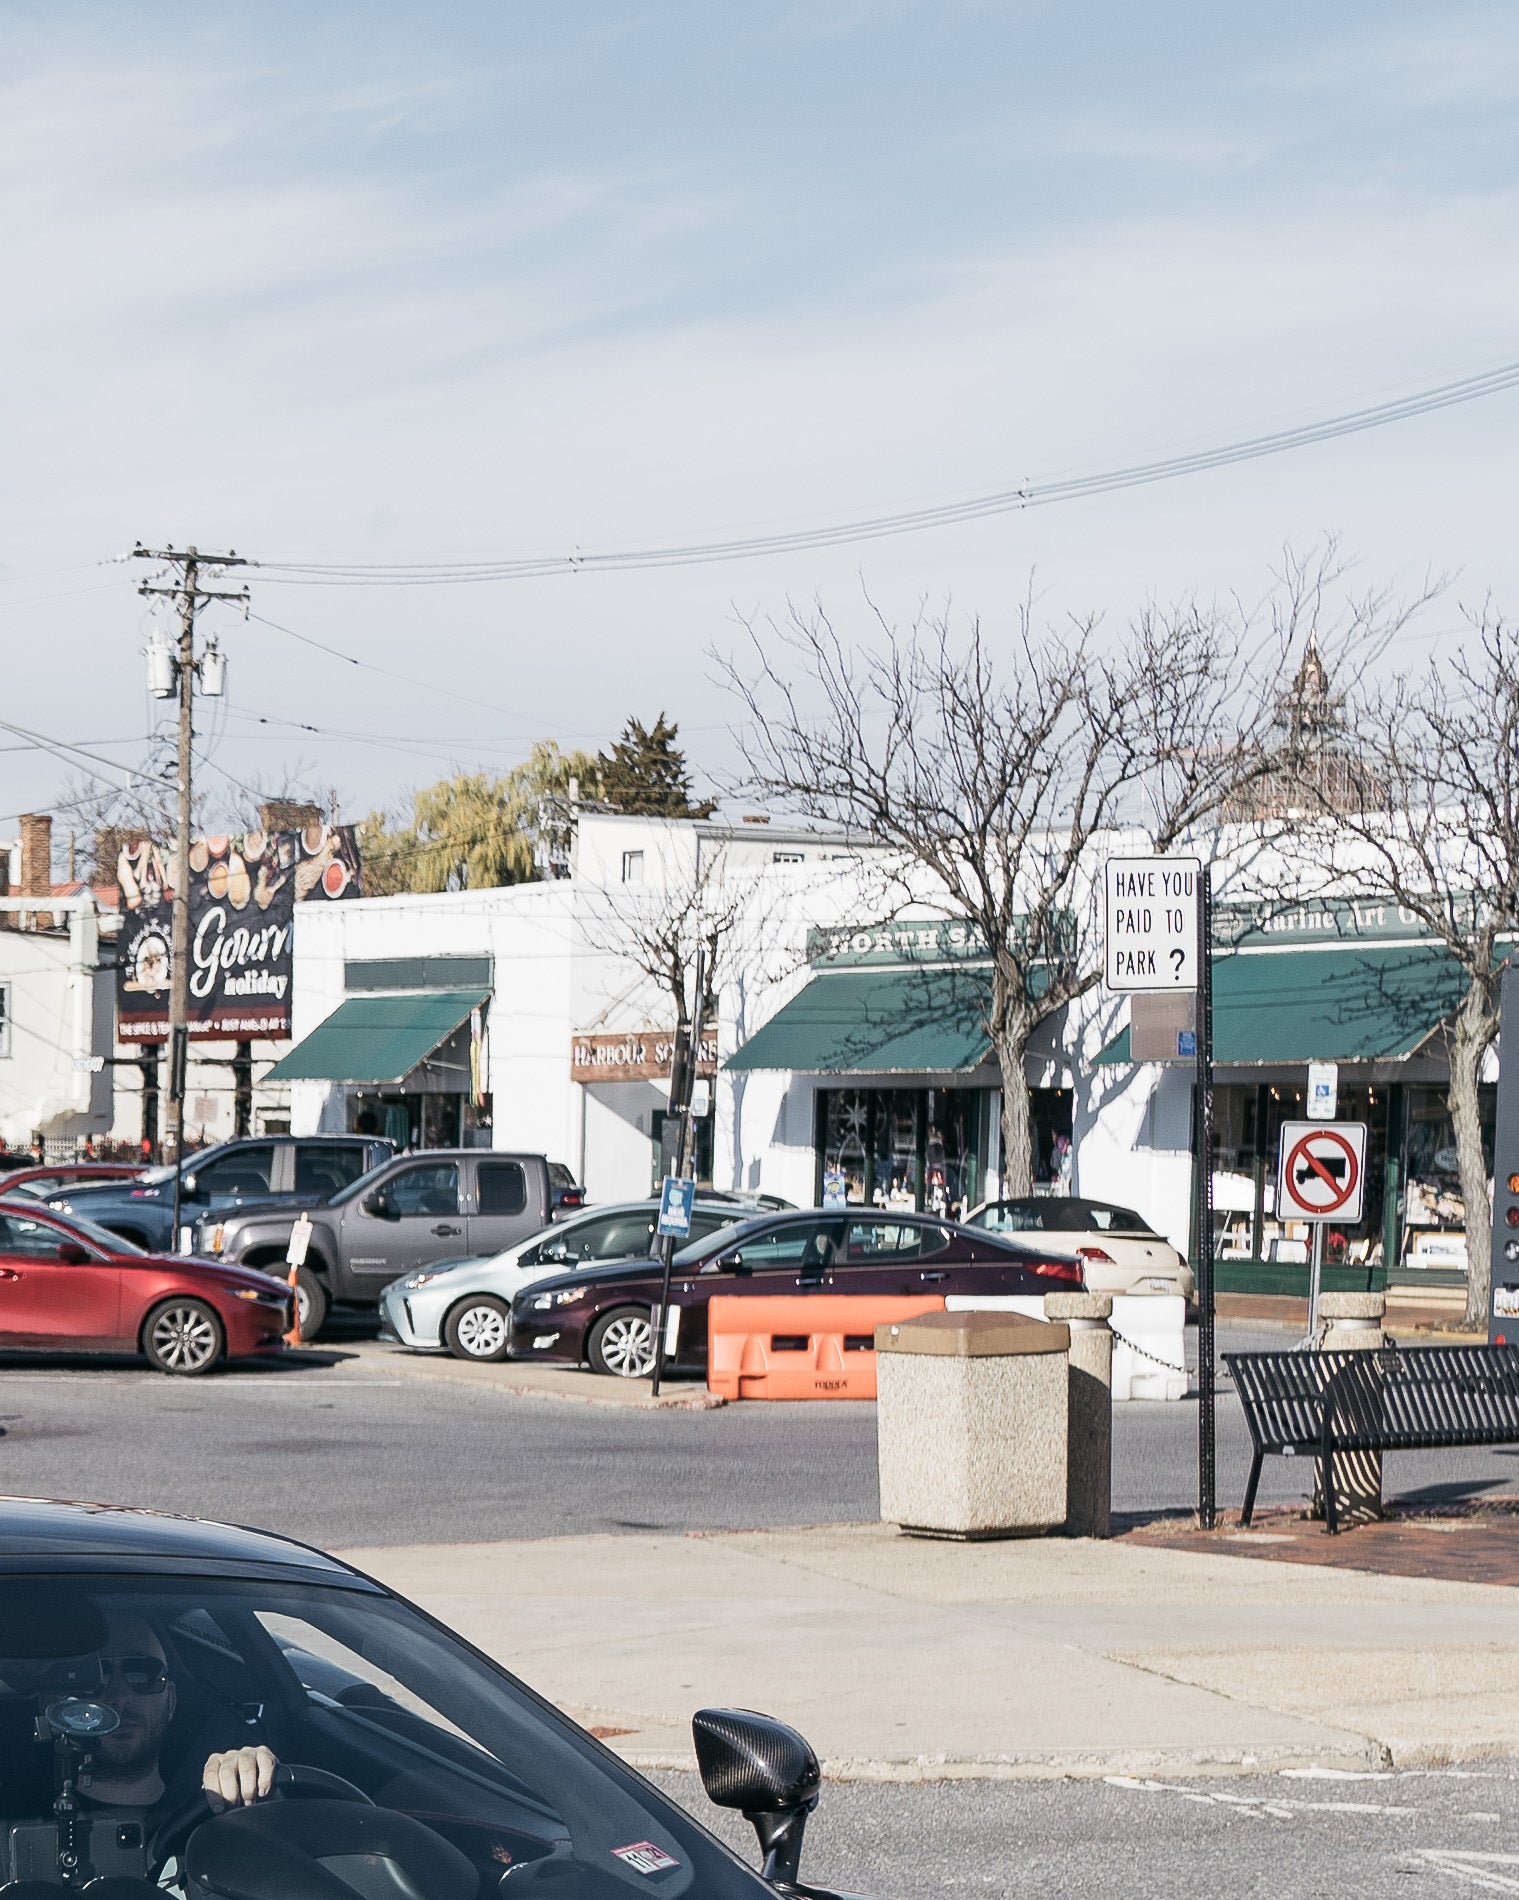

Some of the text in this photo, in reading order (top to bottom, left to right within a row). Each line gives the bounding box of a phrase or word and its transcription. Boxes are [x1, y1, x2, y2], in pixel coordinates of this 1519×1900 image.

[1116, 872, 1194, 898] HAVE YOU
[1116, 909, 1184, 934] PAID TO
[1347, 900, 1387, 928] Art
[830, 929, 939, 955] NORTH
[1116, 948, 1186, 981] PARK ?
[223, 968, 288, 999] holiday
[574, 1043, 647, 1067] HARBOUR
